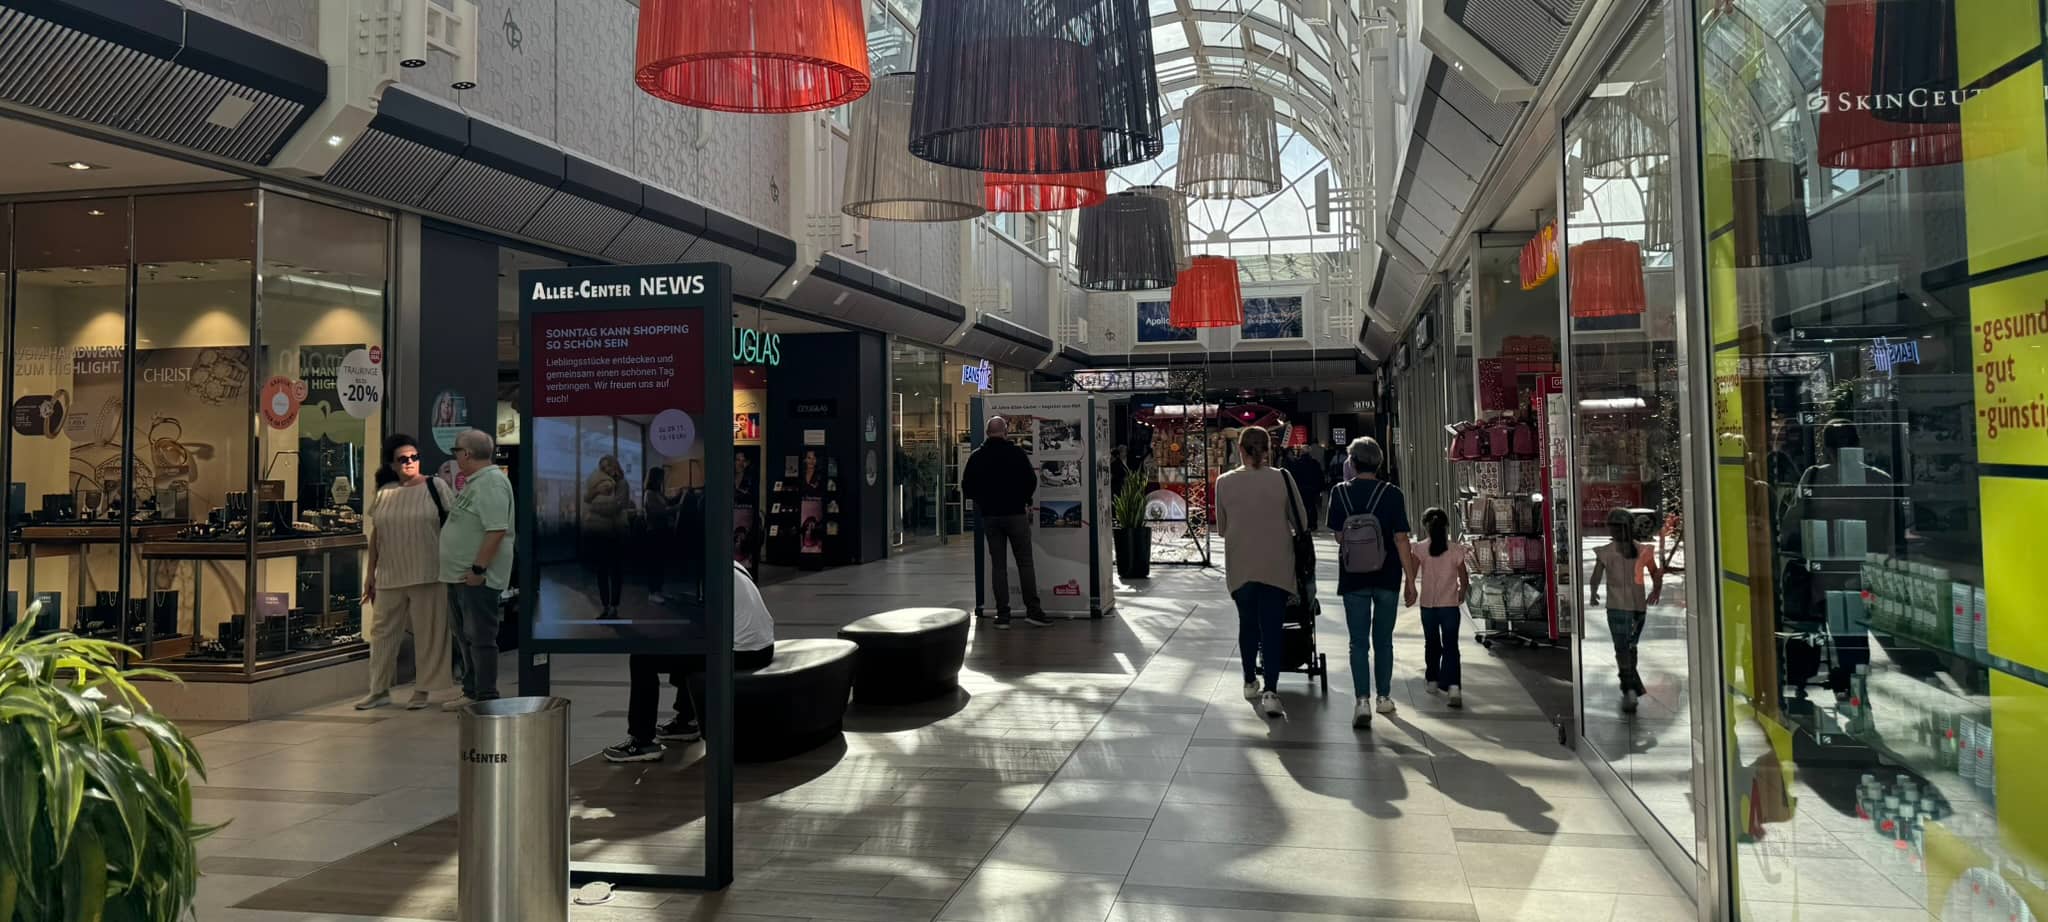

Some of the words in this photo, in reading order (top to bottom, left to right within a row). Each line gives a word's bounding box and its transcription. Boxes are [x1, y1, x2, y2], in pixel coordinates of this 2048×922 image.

[640, 275, 705, 296] NEWS
[546, 328, 598, 339] SONNTAG
[600, 326, 631, 337] KANN
[633, 324, 689, 336] SHOPPING
[546, 341, 561, 350] SO
[563, 337, 602, 349] SCHÖN
[604, 338, 629, 348] SEIN
[15, 362, 44, 376] ZUM
[48, 361, 121, 376] HIGHLIGHT.
[546, 357, 611, 368] Lieblingsstücke
[612, 355, 656, 365] entdecken
[657, 354, 674, 364] und
[143, 367, 192, 382] CHRIST
[344, 365, 380, 377] TRAURINGE
[546, 370, 595, 381] gemeinsam
[596, 369, 619, 377] einen
[621, 367, 657, 376] schönen
[658, 366, 675, 377] Tag
[1976, 353, 2016, 393] -gut
[546, 381, 592, 392] verbringen.
[594, 380, 608, 389] Wir
[609, 379, 637, 389] freuen
[638, 380, 654, 388] uns
[656, 378, 670, 388] auf
[343, 384, 378, 402] -20%
[546, 394, 569, 403] euch!
[1979, 392, 2048, 439] -günsti
